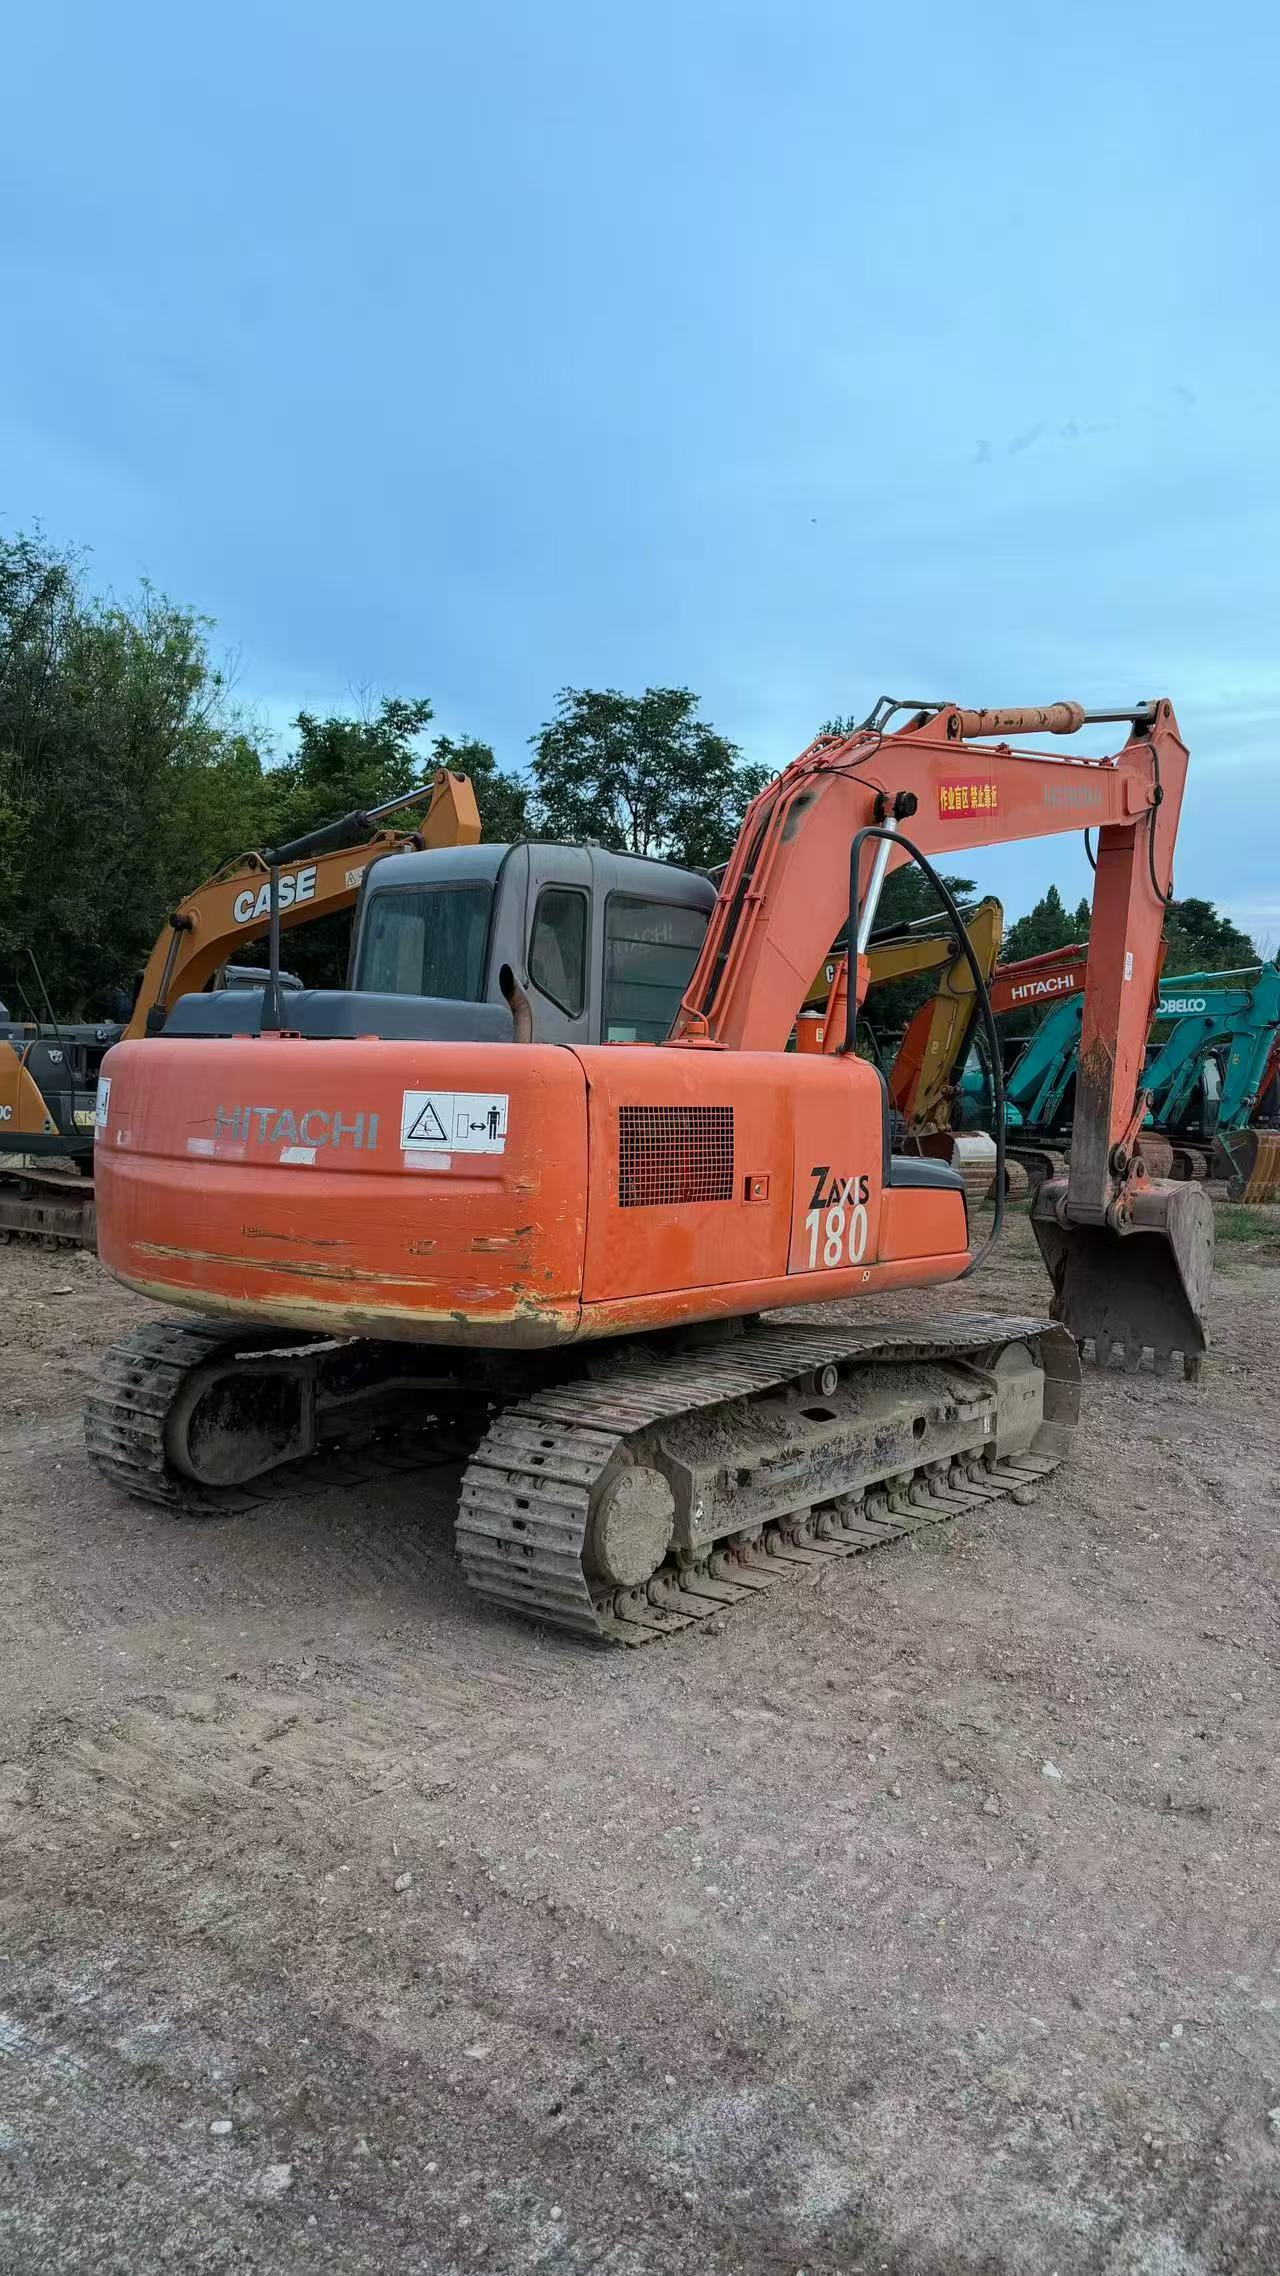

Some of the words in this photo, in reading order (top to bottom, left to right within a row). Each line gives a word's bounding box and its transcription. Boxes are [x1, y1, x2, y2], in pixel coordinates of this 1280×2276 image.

[940, 785, 969, 811] 作业盲区
[970, 783, 998, 808] 禁止靠近
[233, 865, 318, 923] CASE
[1011, 974, 1075, 1000] HITACHI
[1156, 998, 1206, 1013] OBELCO
[215, 1104, 379, 1151] HITACHI
[808, 1166, 870, 1210] ZAXIS
[805, 1205, 868, 1269] 180
